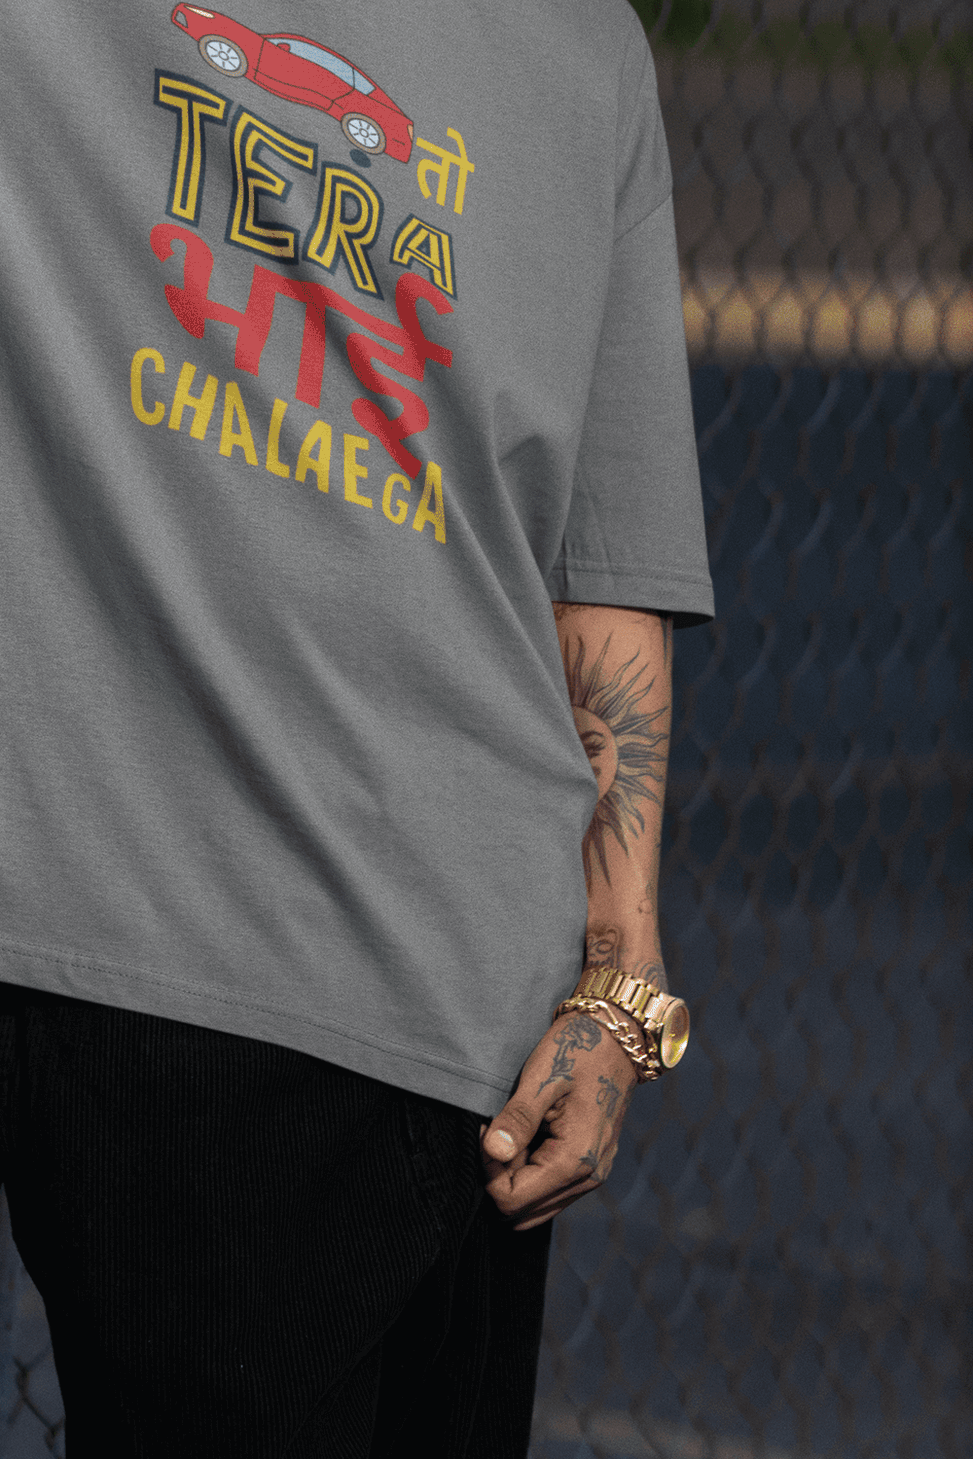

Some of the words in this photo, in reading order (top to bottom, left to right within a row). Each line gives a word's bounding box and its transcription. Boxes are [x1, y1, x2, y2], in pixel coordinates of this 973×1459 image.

[153, 69, 458, 300] TERA
[416, 127, 475, 215] तो
[130, 347, 447, 545] CHALAEGA
[149, 222, 454, 480] भाई
